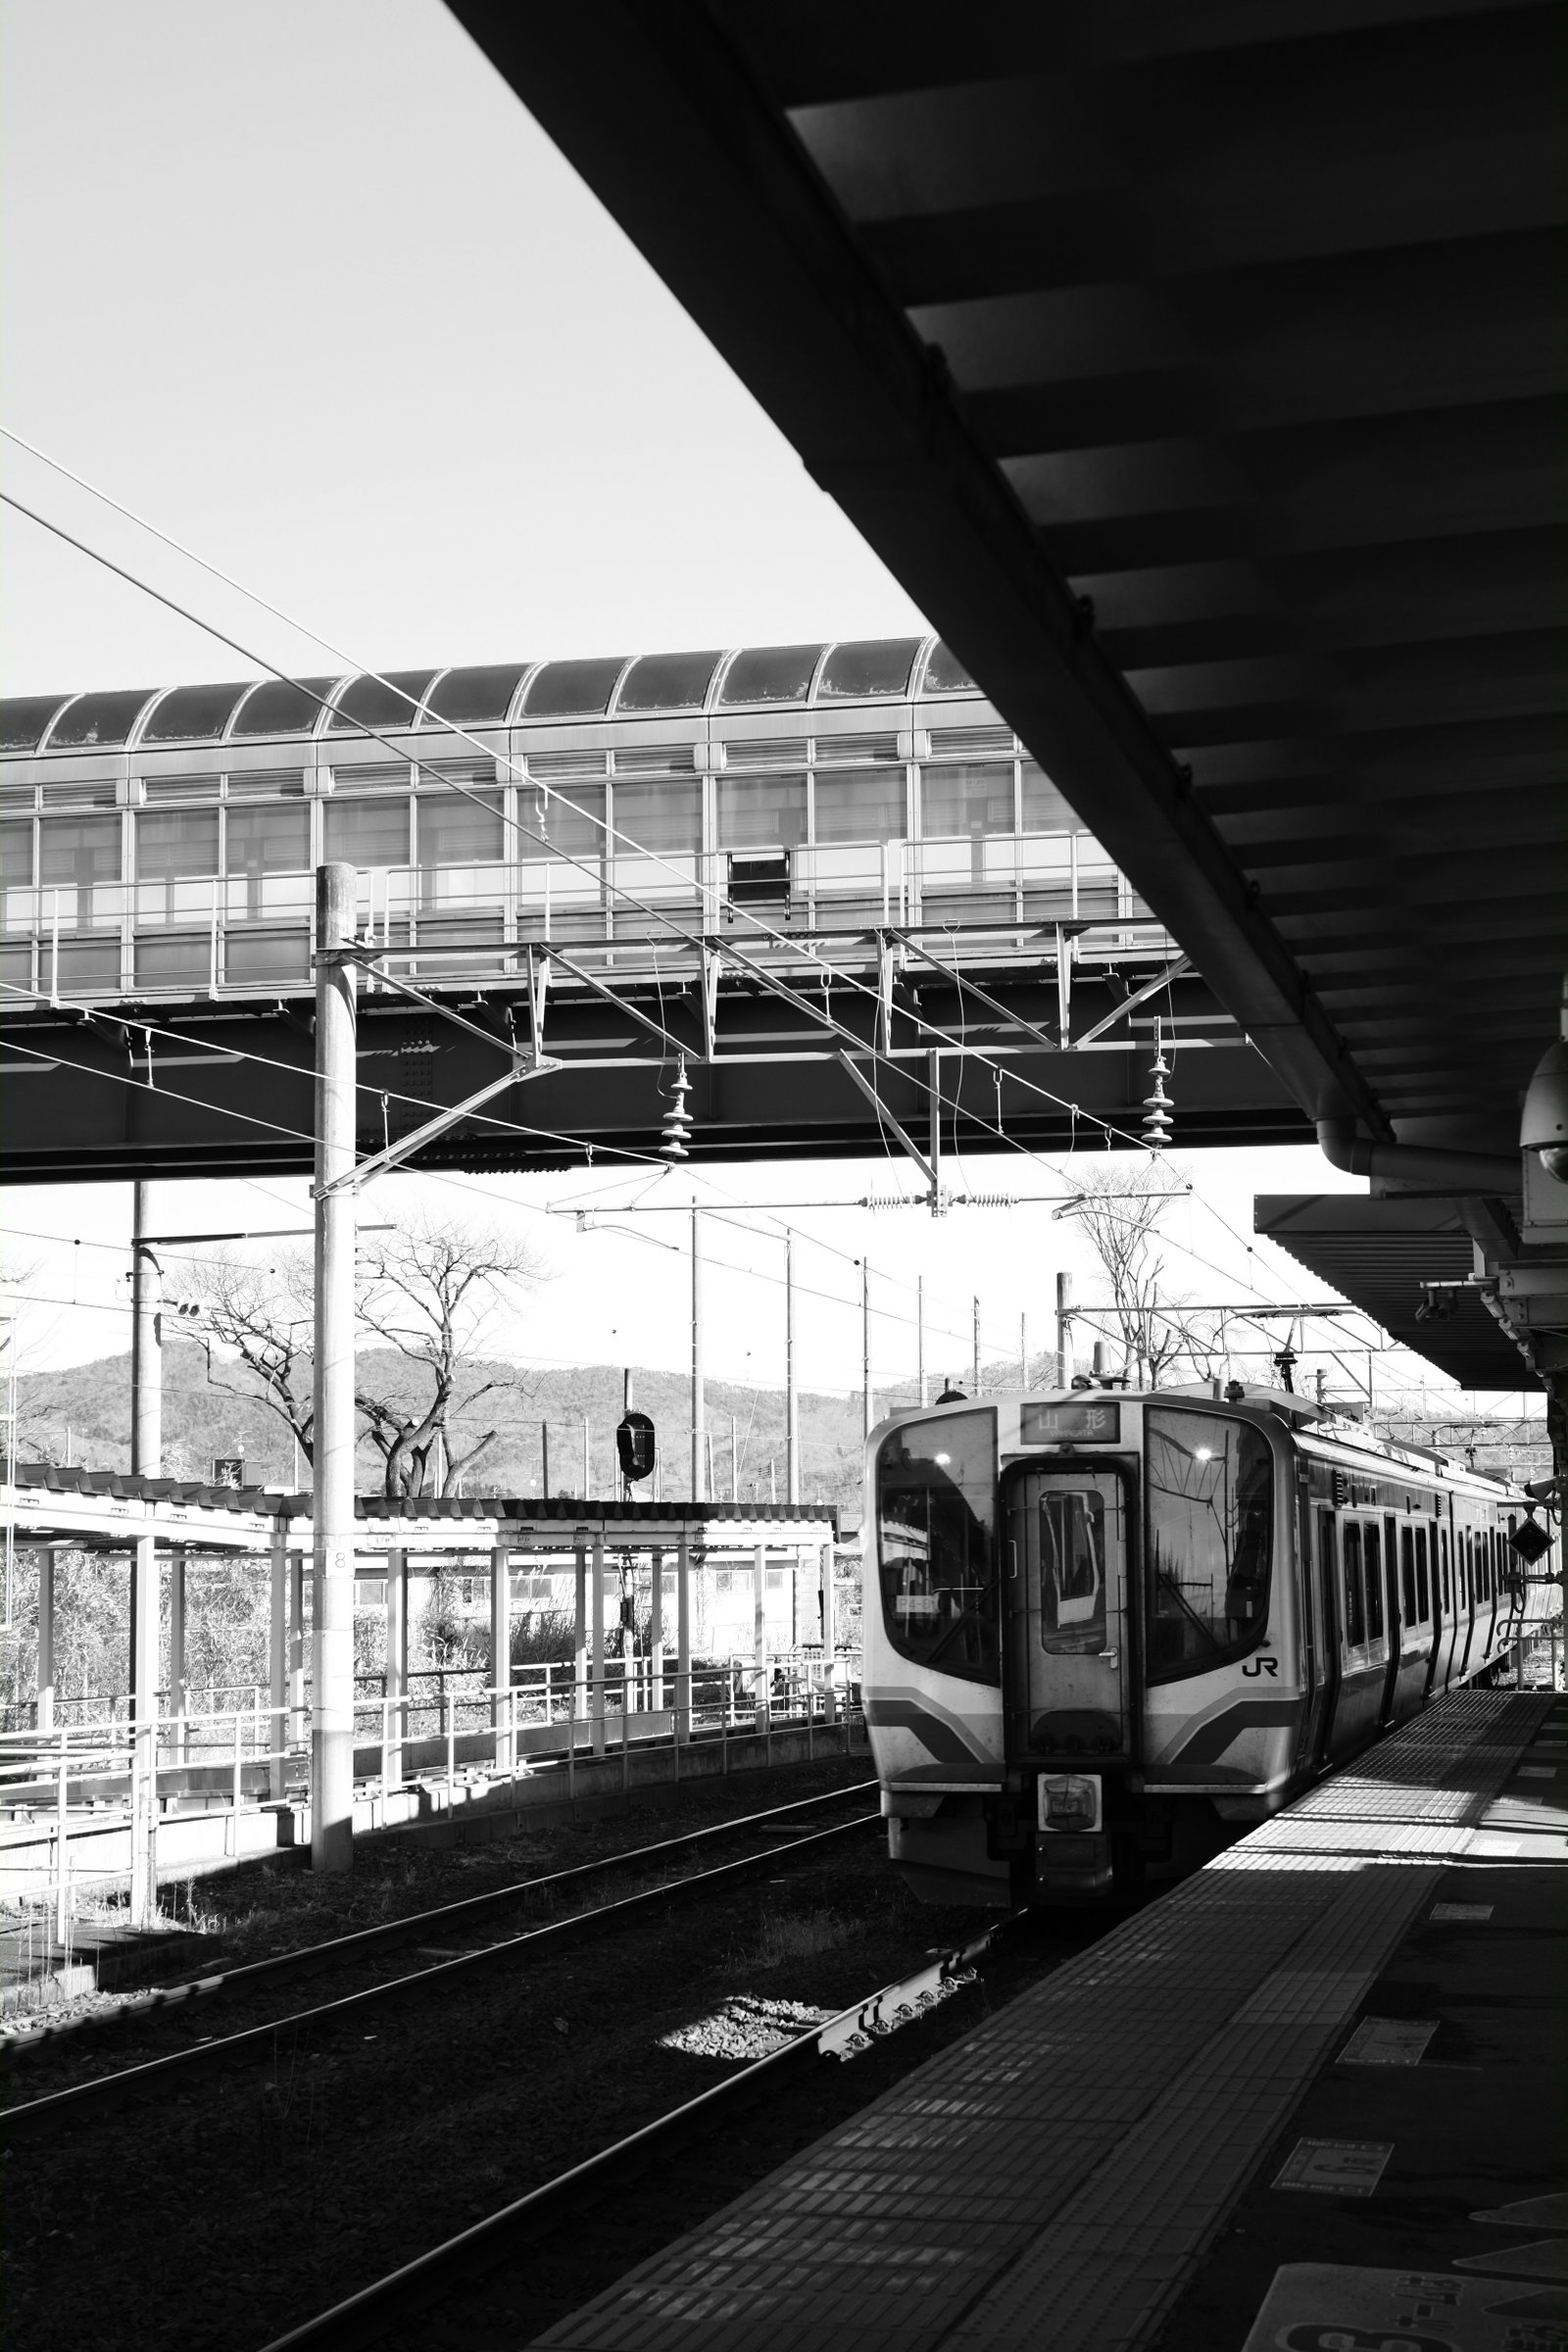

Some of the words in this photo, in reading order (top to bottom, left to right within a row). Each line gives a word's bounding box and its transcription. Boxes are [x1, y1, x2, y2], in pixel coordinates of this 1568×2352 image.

[1039, 1409, 1106, 1430] 山形
[334, 1552, 346, 1569] 8
[1242, 1657, 1279, 1677] JR
